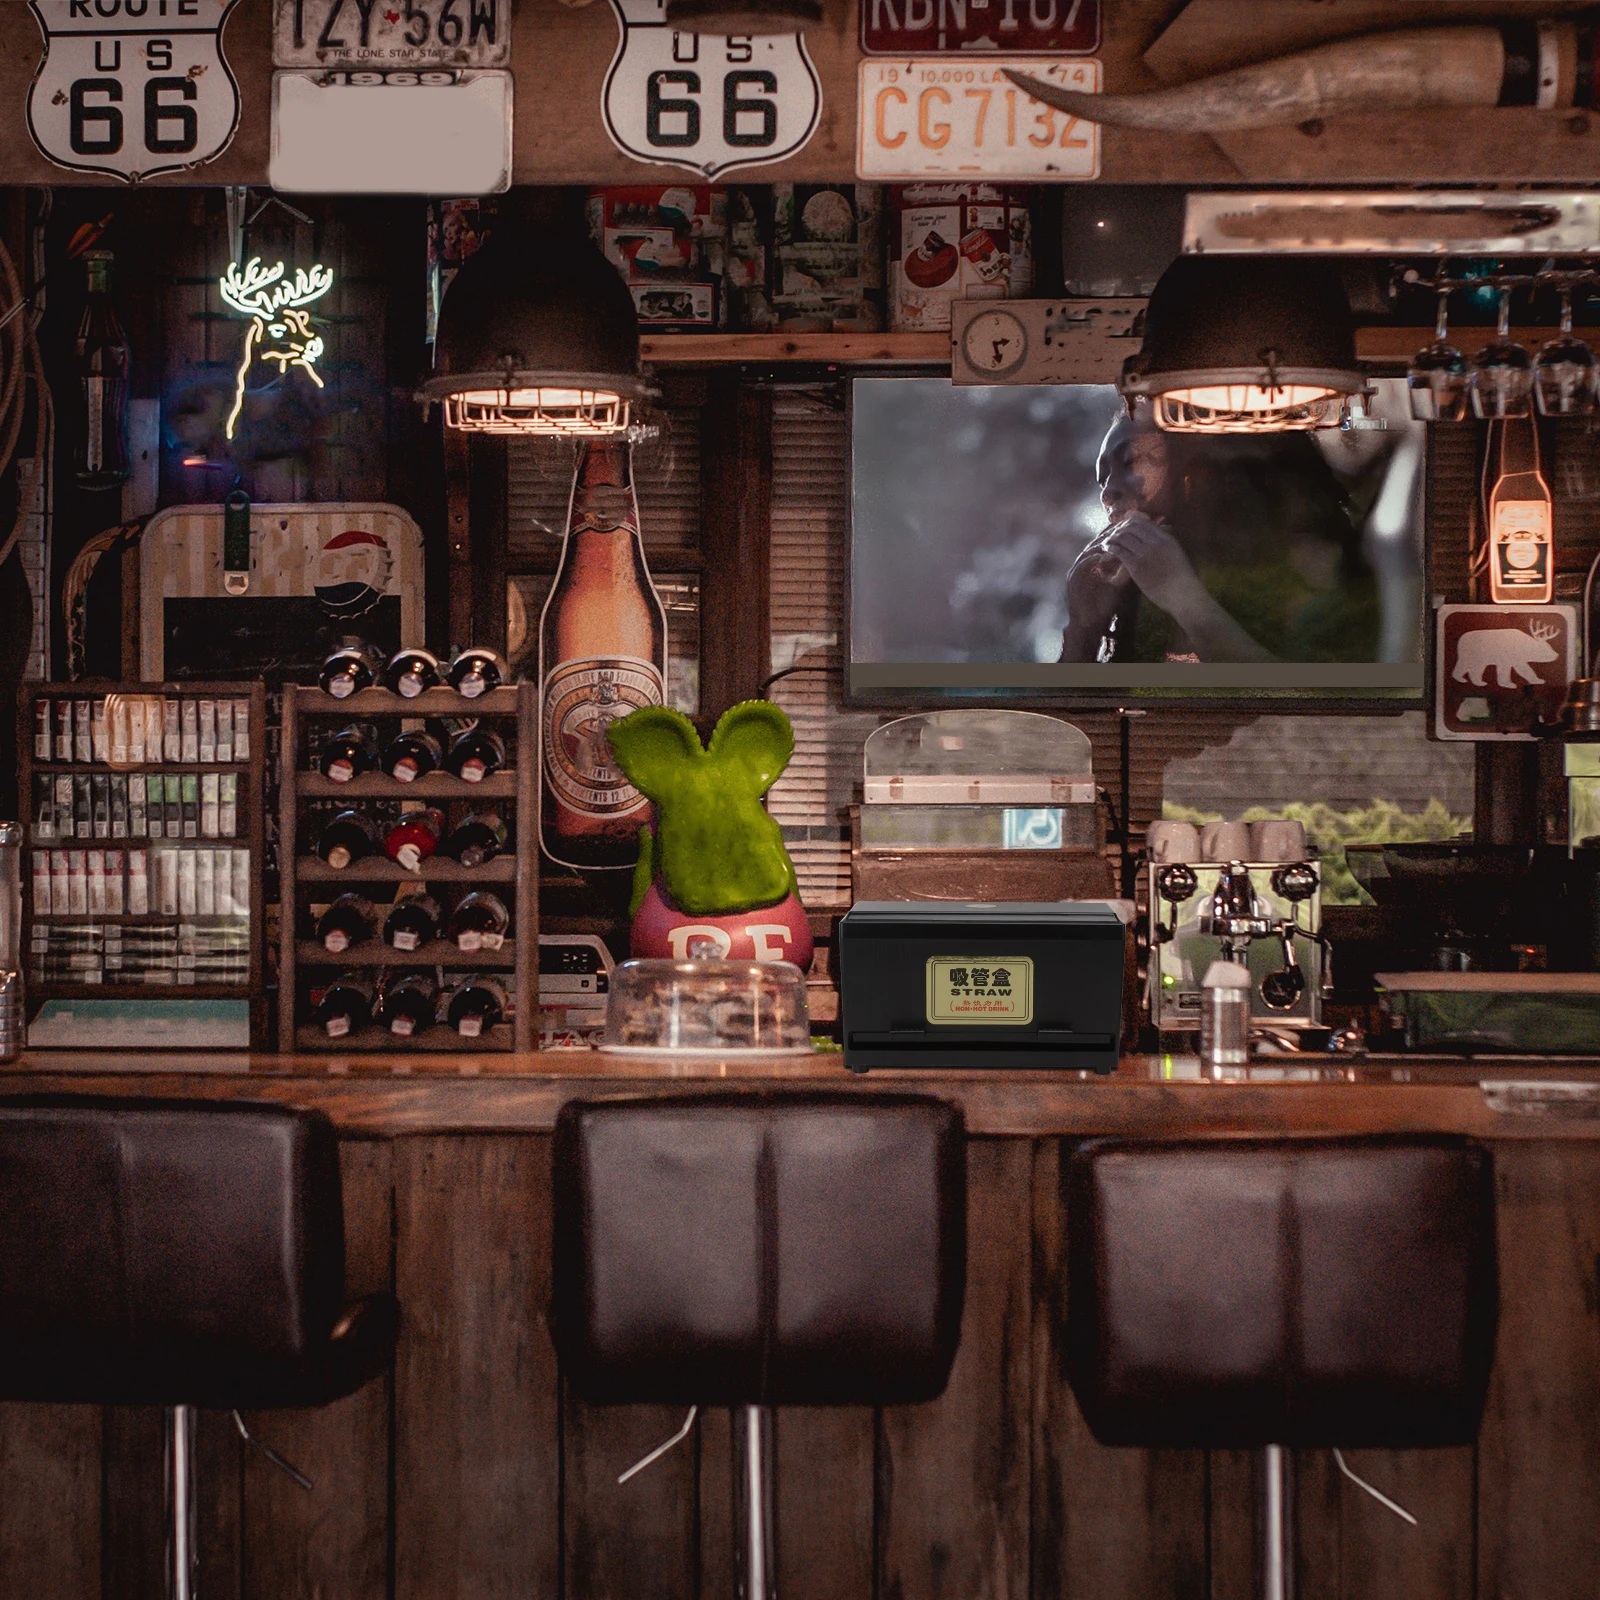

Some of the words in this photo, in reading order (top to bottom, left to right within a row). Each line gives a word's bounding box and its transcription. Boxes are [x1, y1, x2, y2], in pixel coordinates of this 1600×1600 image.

[335, 72, 453, 86] 1969
[879, 69, 899, 83] 19
[1059, 69, 1086, 84] 74
[70, 76, 198, 155] 66
[647, 70, 777, 147] 66
[949, 968, 1012, 987] 吸管盒
[950, 988, 1013, 996] STRAW
